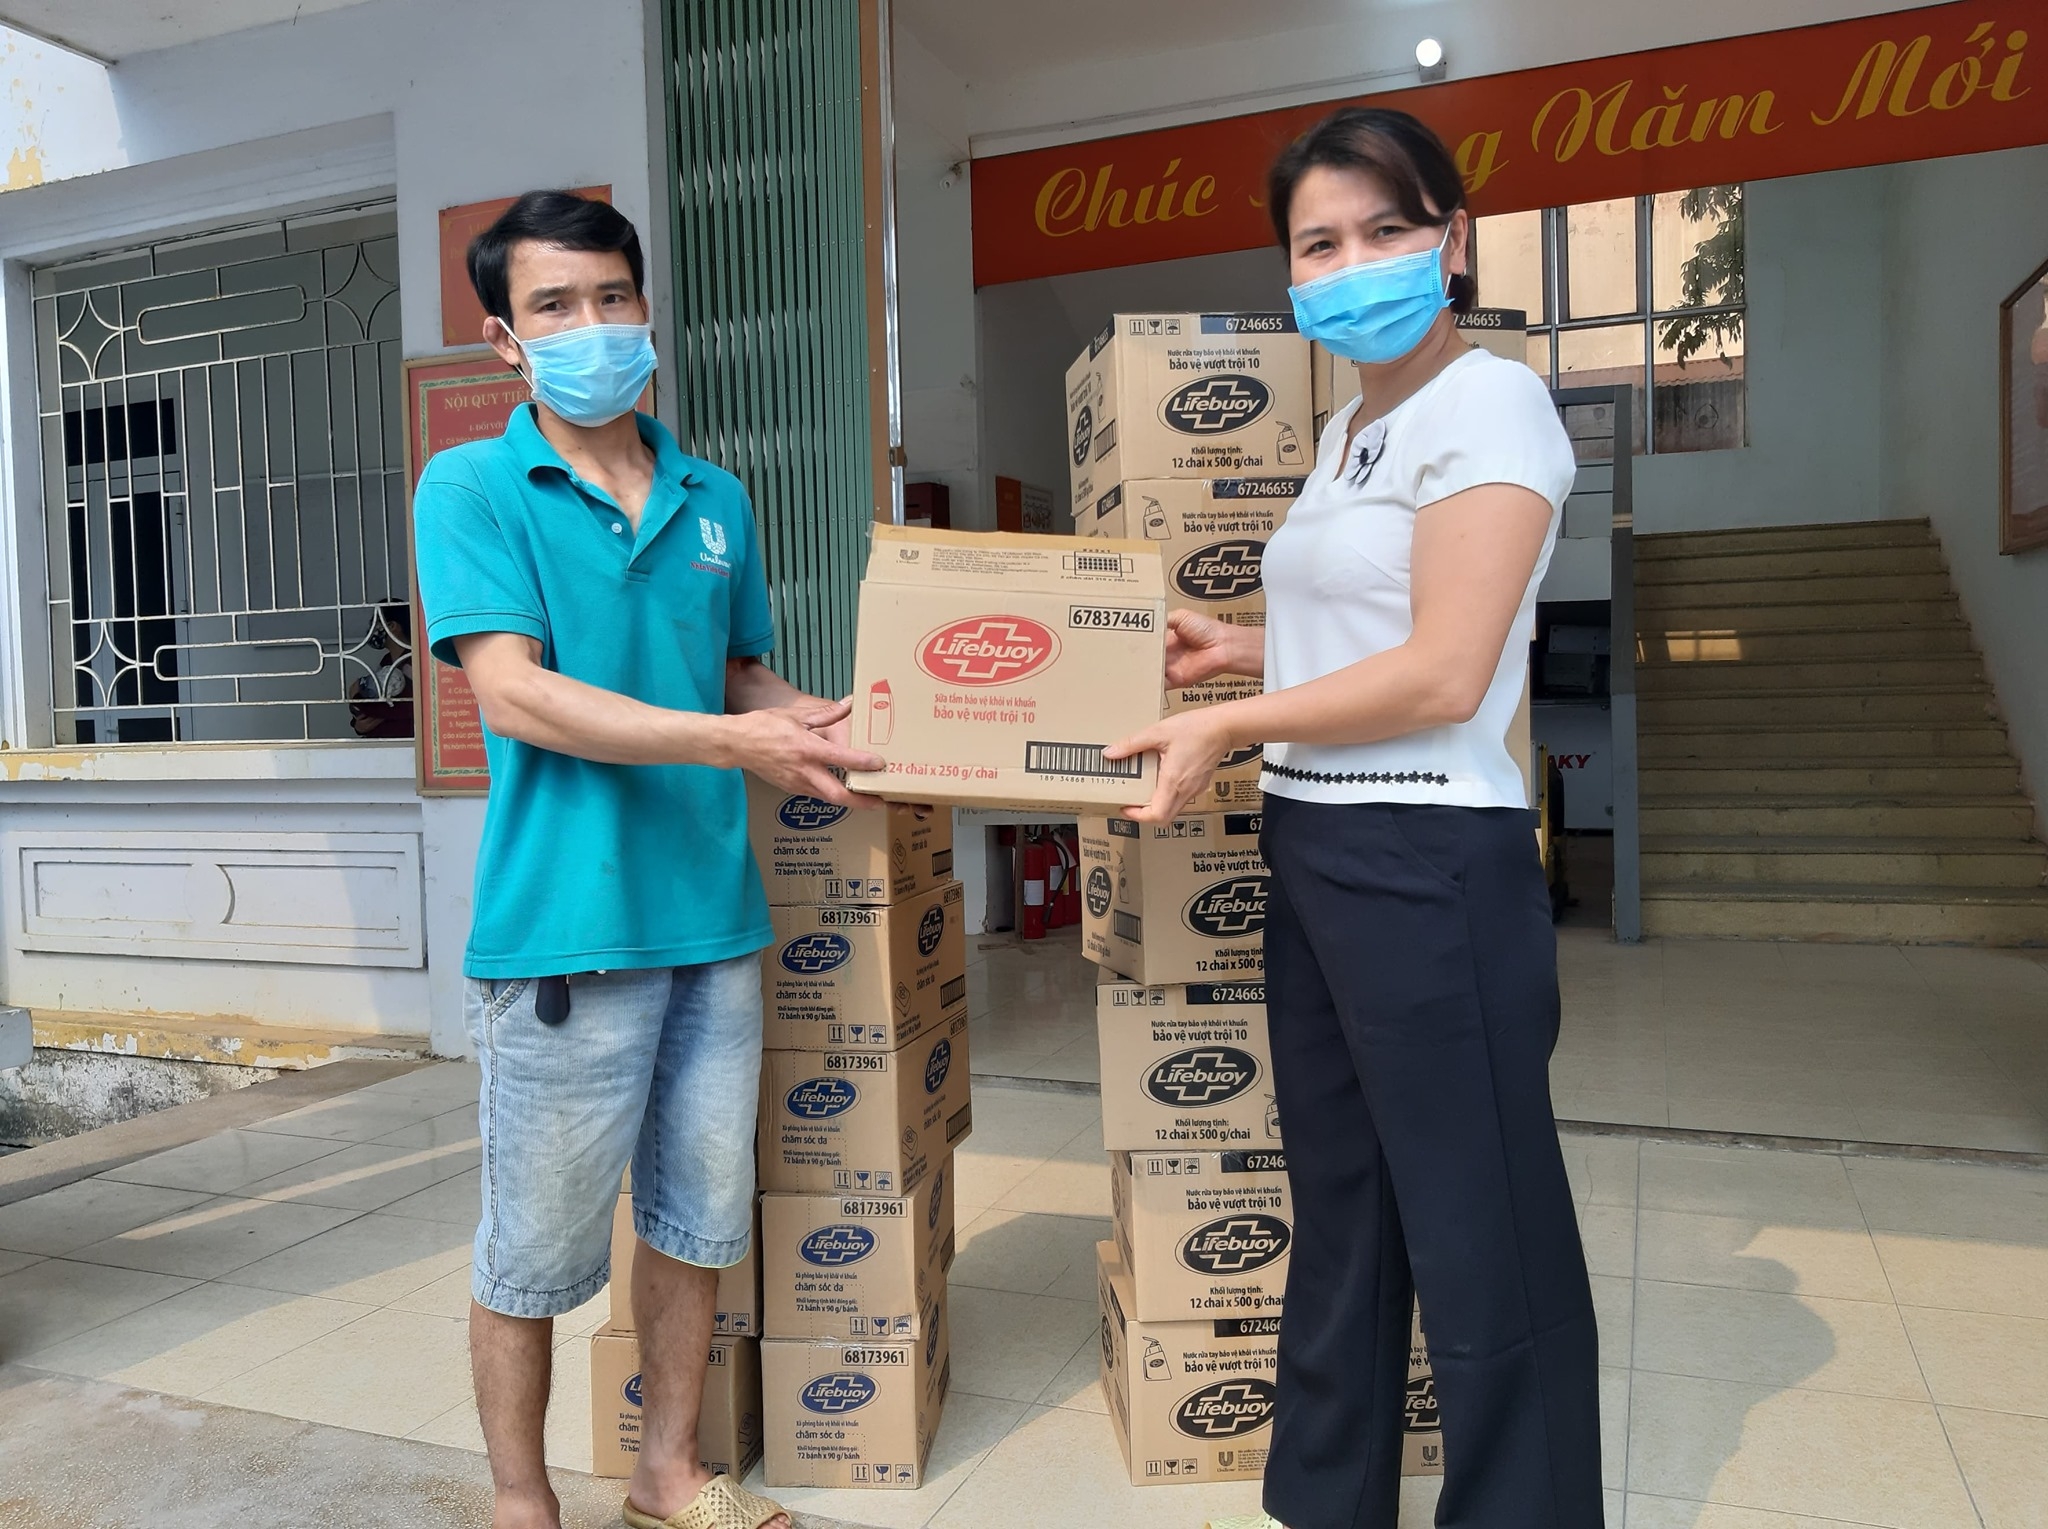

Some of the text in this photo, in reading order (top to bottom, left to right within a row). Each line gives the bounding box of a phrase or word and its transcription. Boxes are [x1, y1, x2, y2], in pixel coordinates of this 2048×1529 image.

[1531, 79, 1783, 166] Năm
[1811, 21, 2030, 127] Mới
[1034, 158, 1219, 237] Chúc
[1226, 318, 1283, 331] 67246655
[1453, 314, 1501, 327] 7246655
[1170, 358, 1260, 373] bảo vệ vượt trội 10
[444, 393, 468, 411] NỘI
[472, 392, 499, 409] QUY
[1172, 396, 1260, 413] Lifebuoy
[1172, 458, 1183, 468] 12
[1186, 457, 1205, 468] chai
[1207, 459, 1213, 467] x
[1215, 457, 1232, 467] 500
[1238, 482, 1295, 495] 67246655
[1184, 520, 1273, 535] bảo vệ vượt trội 10
[1184, 562, 1261, 577] Lifebuo
[1073, 610, 1151, 629] 67837446
[933, 638, 1043, 664] Lifebuoy
[1182, 690, 1200, 702] bảo
[1202, 691, 1213, 705] vệ
[934, 705, 1035, 725] bảo vệ vượt trội 10
[890, 763, 903, 773] 24
[906, 763, 927, 775] chai
[930, 767, 936, 776] x
[939, 766, 959, 777] 250
[785, 804, 843, 815] Lifebuoy
[774, 846, 820, 855] chăm sóc da
[1194, 861, 1212, 872] bảo
[1214, 861, 1226, 875] vệ
[1228, 860, 1250, 873] vượt
[1196, 900, 1266, 915] Lifebuo
[822, 911, 877, 925] 68173961
[787, 947, 845, 959] Lifebuoy
[1196, 958, 1255, 971] 12 chai x 500
[776, 990, 822, 999] chăm sóc da
[1213, 988, 1265, 1001] 6724665
[1153, 1029, 1247, 1044] bảo vệ vượt trội 10
[827, 1056, 883, 1069] 68173961
[1155, 1068, 1247, 1085] Lifebuoy
[793, 1092, 852, 1105] Lifebuoy
[782, 1134, 828, 1145] chăm sóc da
[1156, 1130, 1167, 1140] 12
[1170, 1128, 1189, 1140] chai
[1192, 1131, 1197, 1139] x
[1200, 1129, 1218, 1139] 500
[1247, 1155, 1286, 1169] 67246
[844, 1202, 904, 1215] 68173961
[1188, 1197, 1281, 1212] bảo vệ vượt trội 10
[807, 1239, 869, 1252] Lifebuoy
[1190, 1237, 1281, 1253] Lifebuoy
[795, 1282, 844, 1292] chăm sóc da
[1190, 1298, 1202, 1308] 12
[1204, 1297, 1224, 1308] chai
[1226, 1299, 1232, 1307] x
[1234, 1296, 1252, 1307] 500
[1240, 1320, 1281, 1333] 67246
[845, 1350, 905, 1364] 68173961
[1185, 1358, 1276, 1375] bảo vệ vượt trội 10
[808, 1386, 871, 1400] Lifebuoy
[1184, 1402, 1274, 1418] Lifebuoy
[619, 1422, 639, 1432] chăm
[796, 1430, 845, 1439] chăm sóc da
